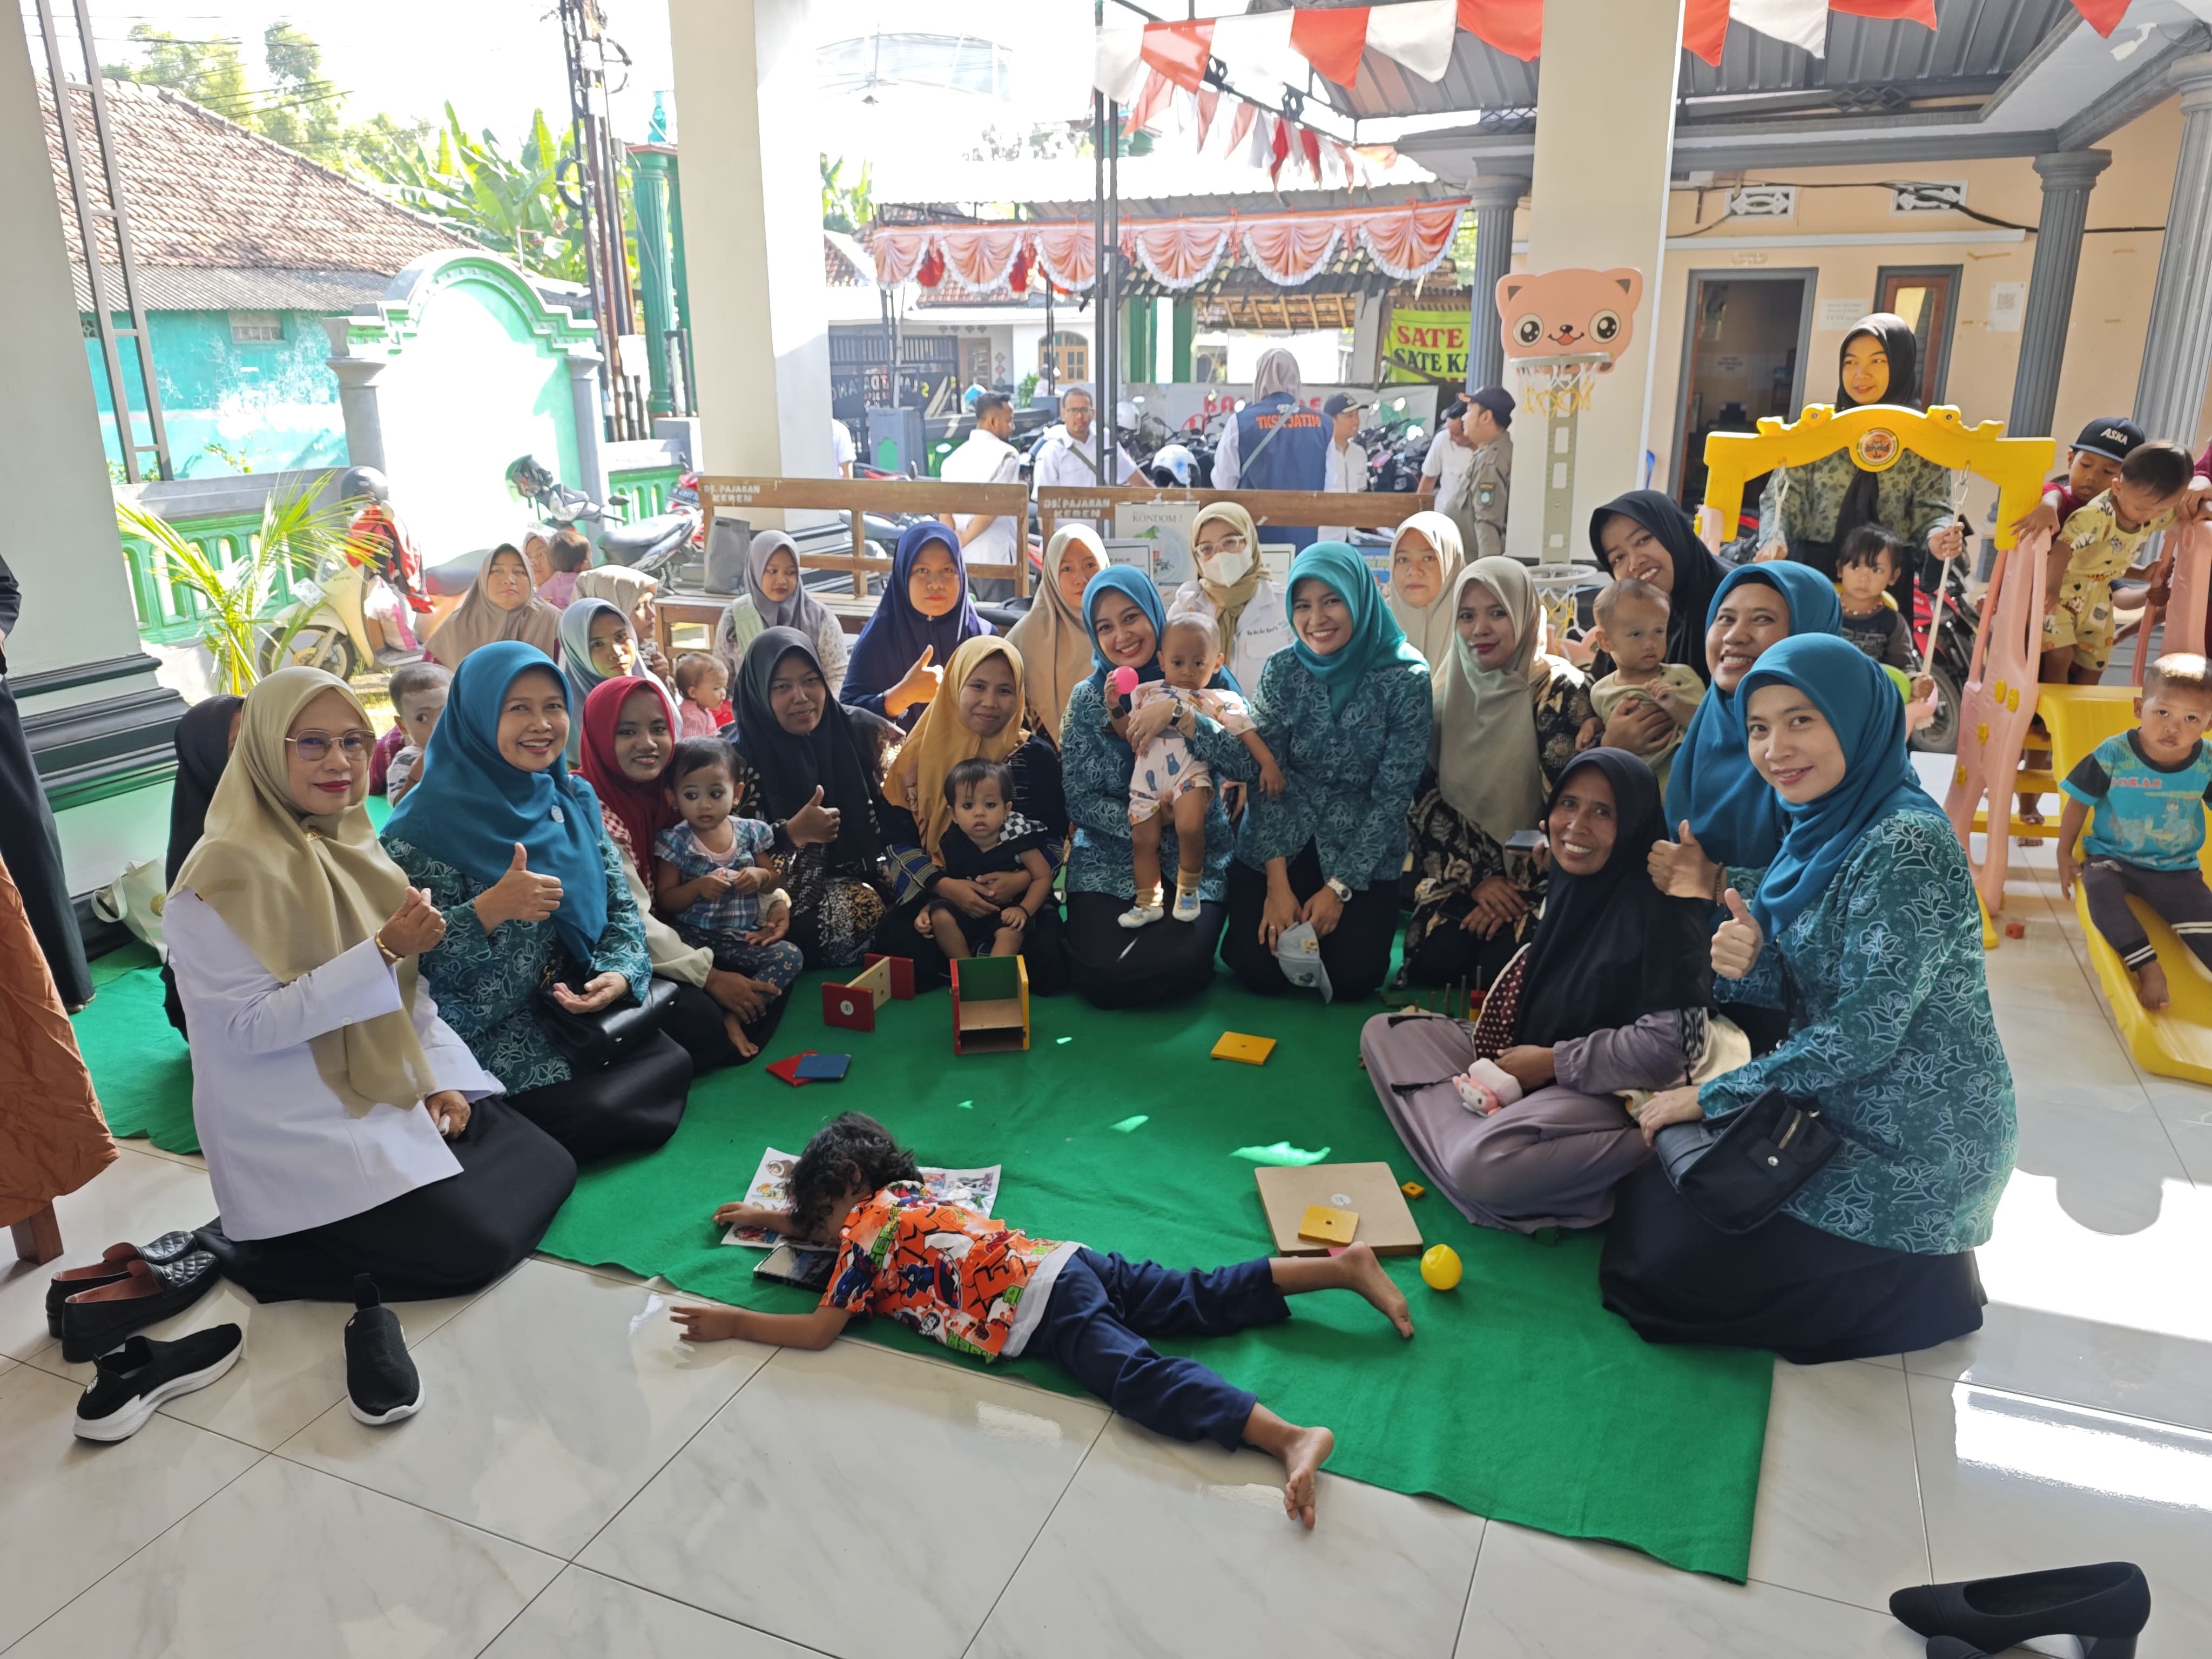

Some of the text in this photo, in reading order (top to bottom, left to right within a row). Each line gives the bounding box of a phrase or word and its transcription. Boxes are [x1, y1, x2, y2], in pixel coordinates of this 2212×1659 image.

[1397, 325, 1464, 349] SATE
[1394, 348, 1442, 372] SATE
[1287, 414, 1322, 428] JATIM
[2100, 428, 2128, 446] ASKA
[720, 485, 760, 494] PAJARAN
[712, 494, 752, 502] KEREN
[1062, 498, 1110, 508] PAJARAN
[1054, 509, 1101, 518] KEREN
[1132, 514, 1176, 523] KONDOM
